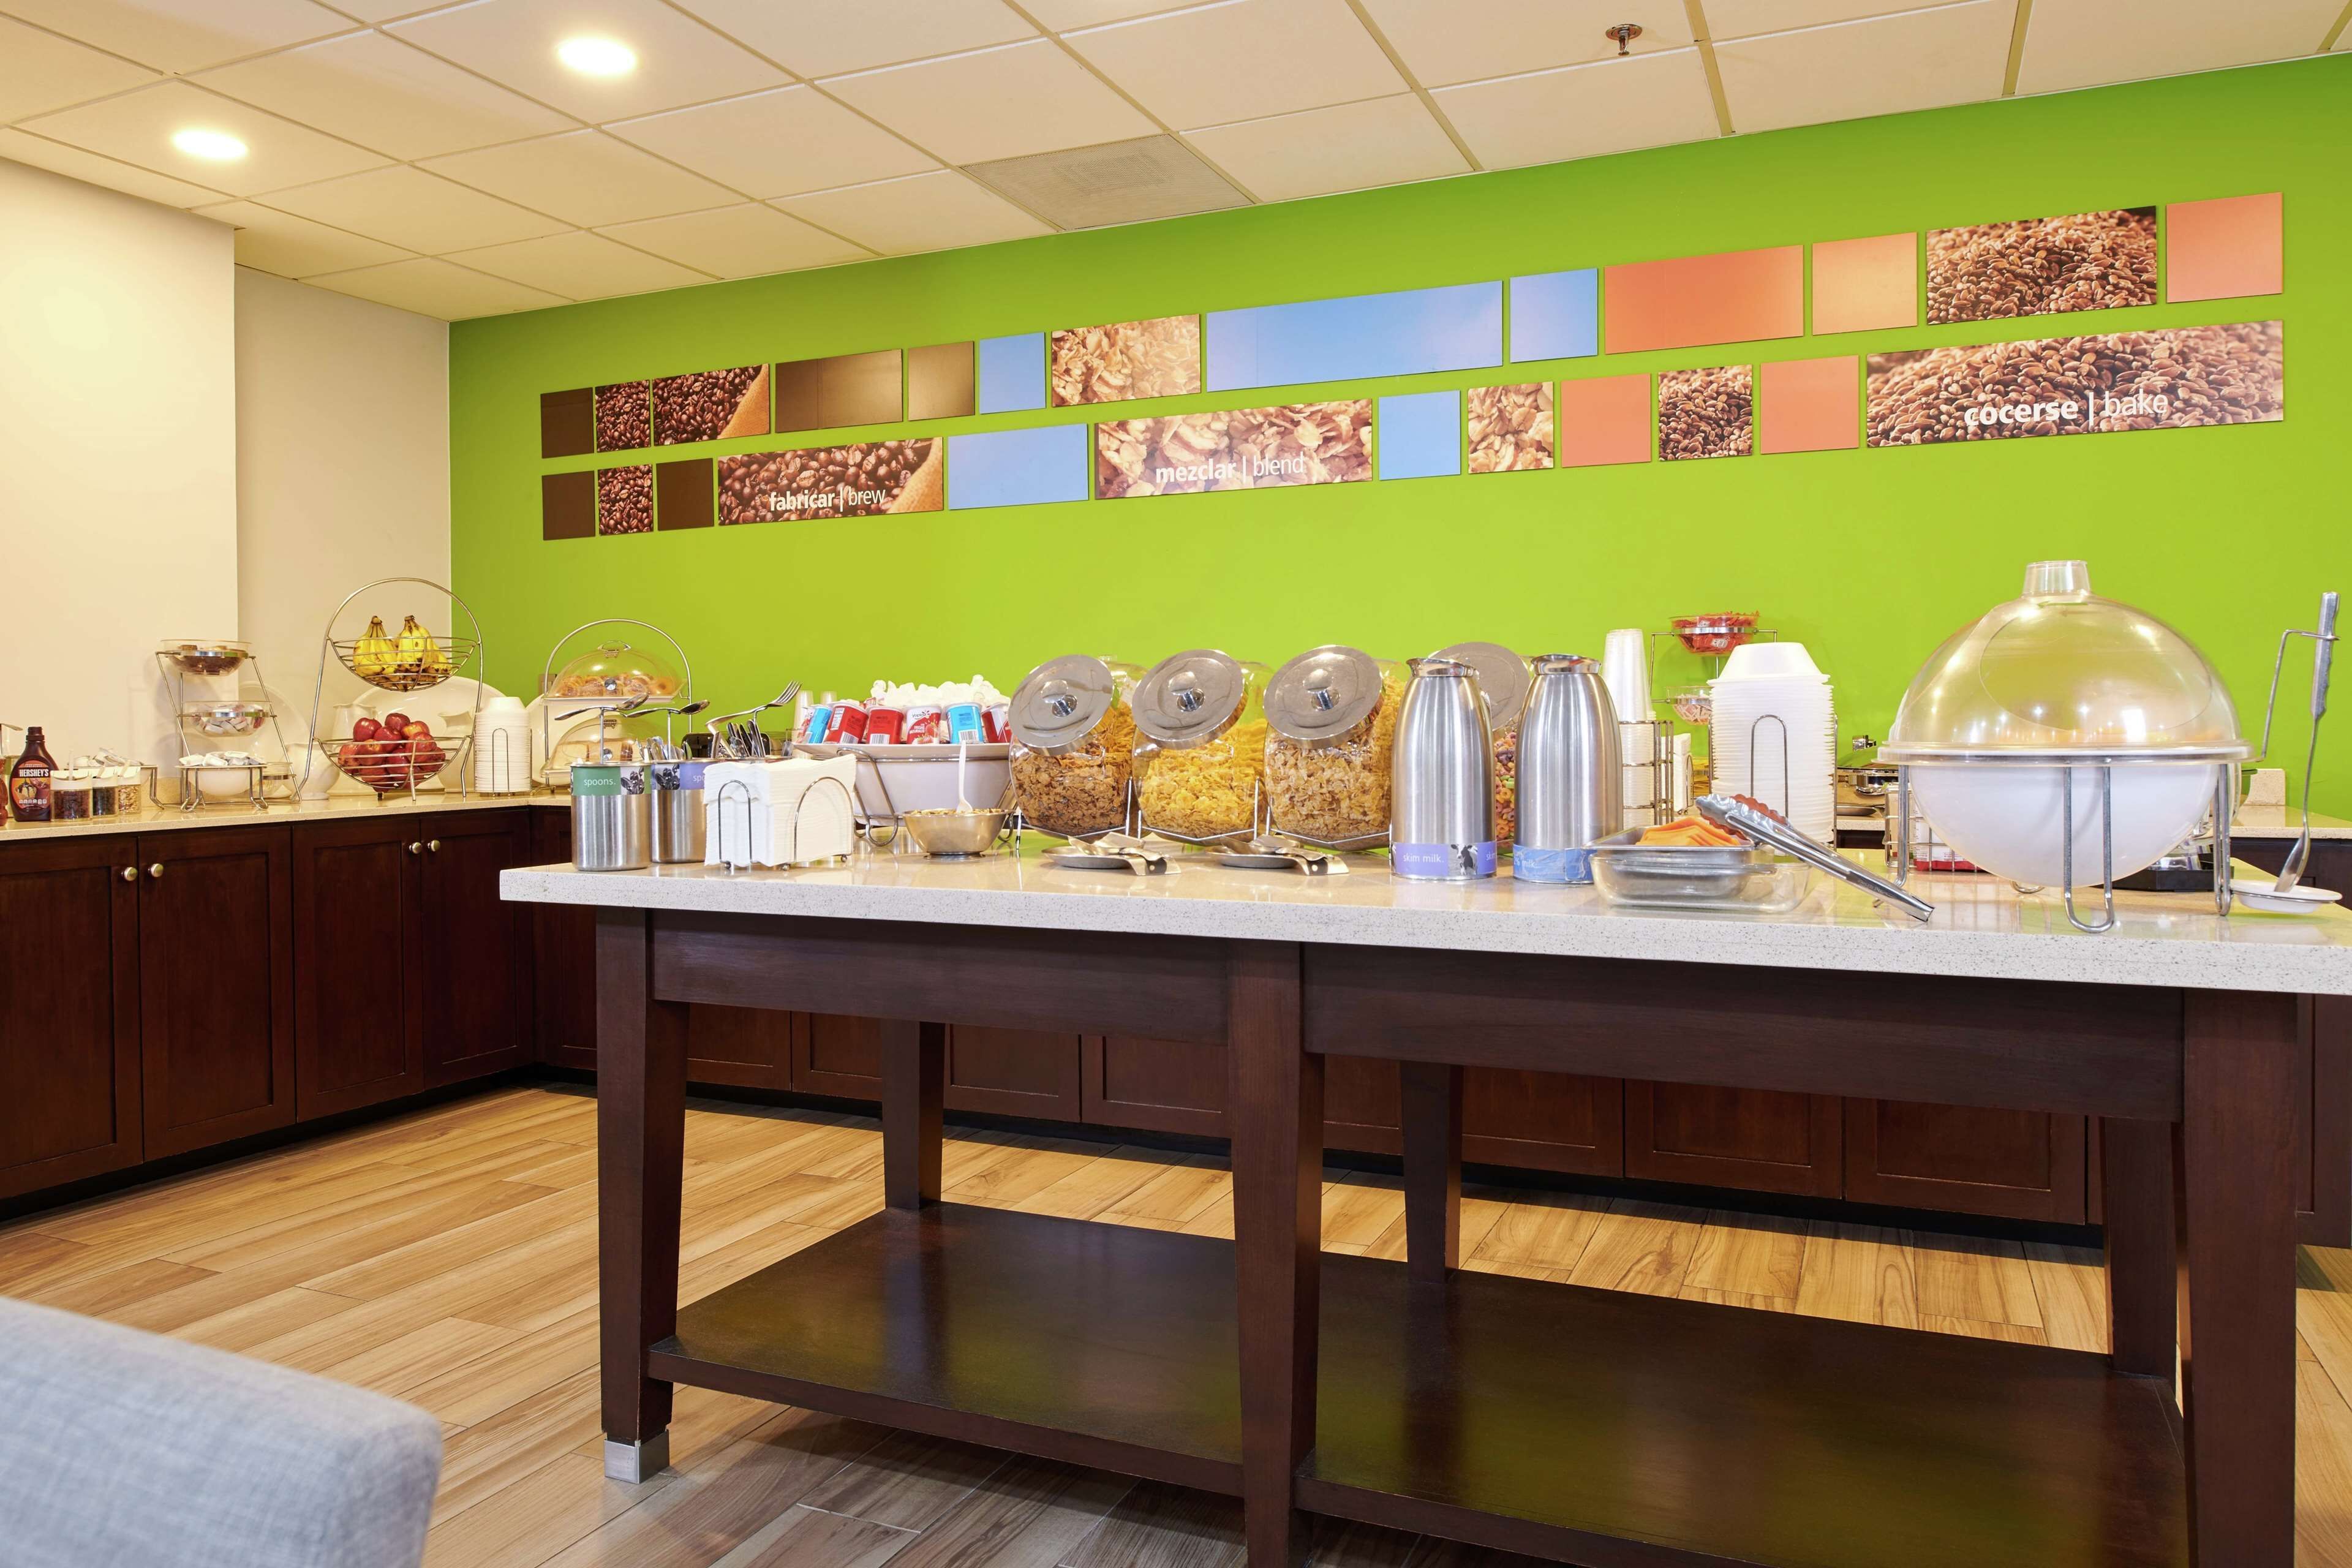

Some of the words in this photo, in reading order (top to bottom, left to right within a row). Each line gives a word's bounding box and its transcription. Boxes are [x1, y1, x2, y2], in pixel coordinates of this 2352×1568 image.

[1964, 399, 2079, 427] cocerse
[2104, 388, 2169, 417] bake
[1155, 458, 1237, 483] mezclar
[1253, 451, 1304, 477] blend
[770, 491, 835, 511] fabricar
[848, 486, 886, 506] brew
[19, 769, 49, 778] HERSHEY'S
[584, 778, 616, 788] spoons.
[1403, 853, 1420, 863] skim
[1423, 853, 1444, 863] milk.
